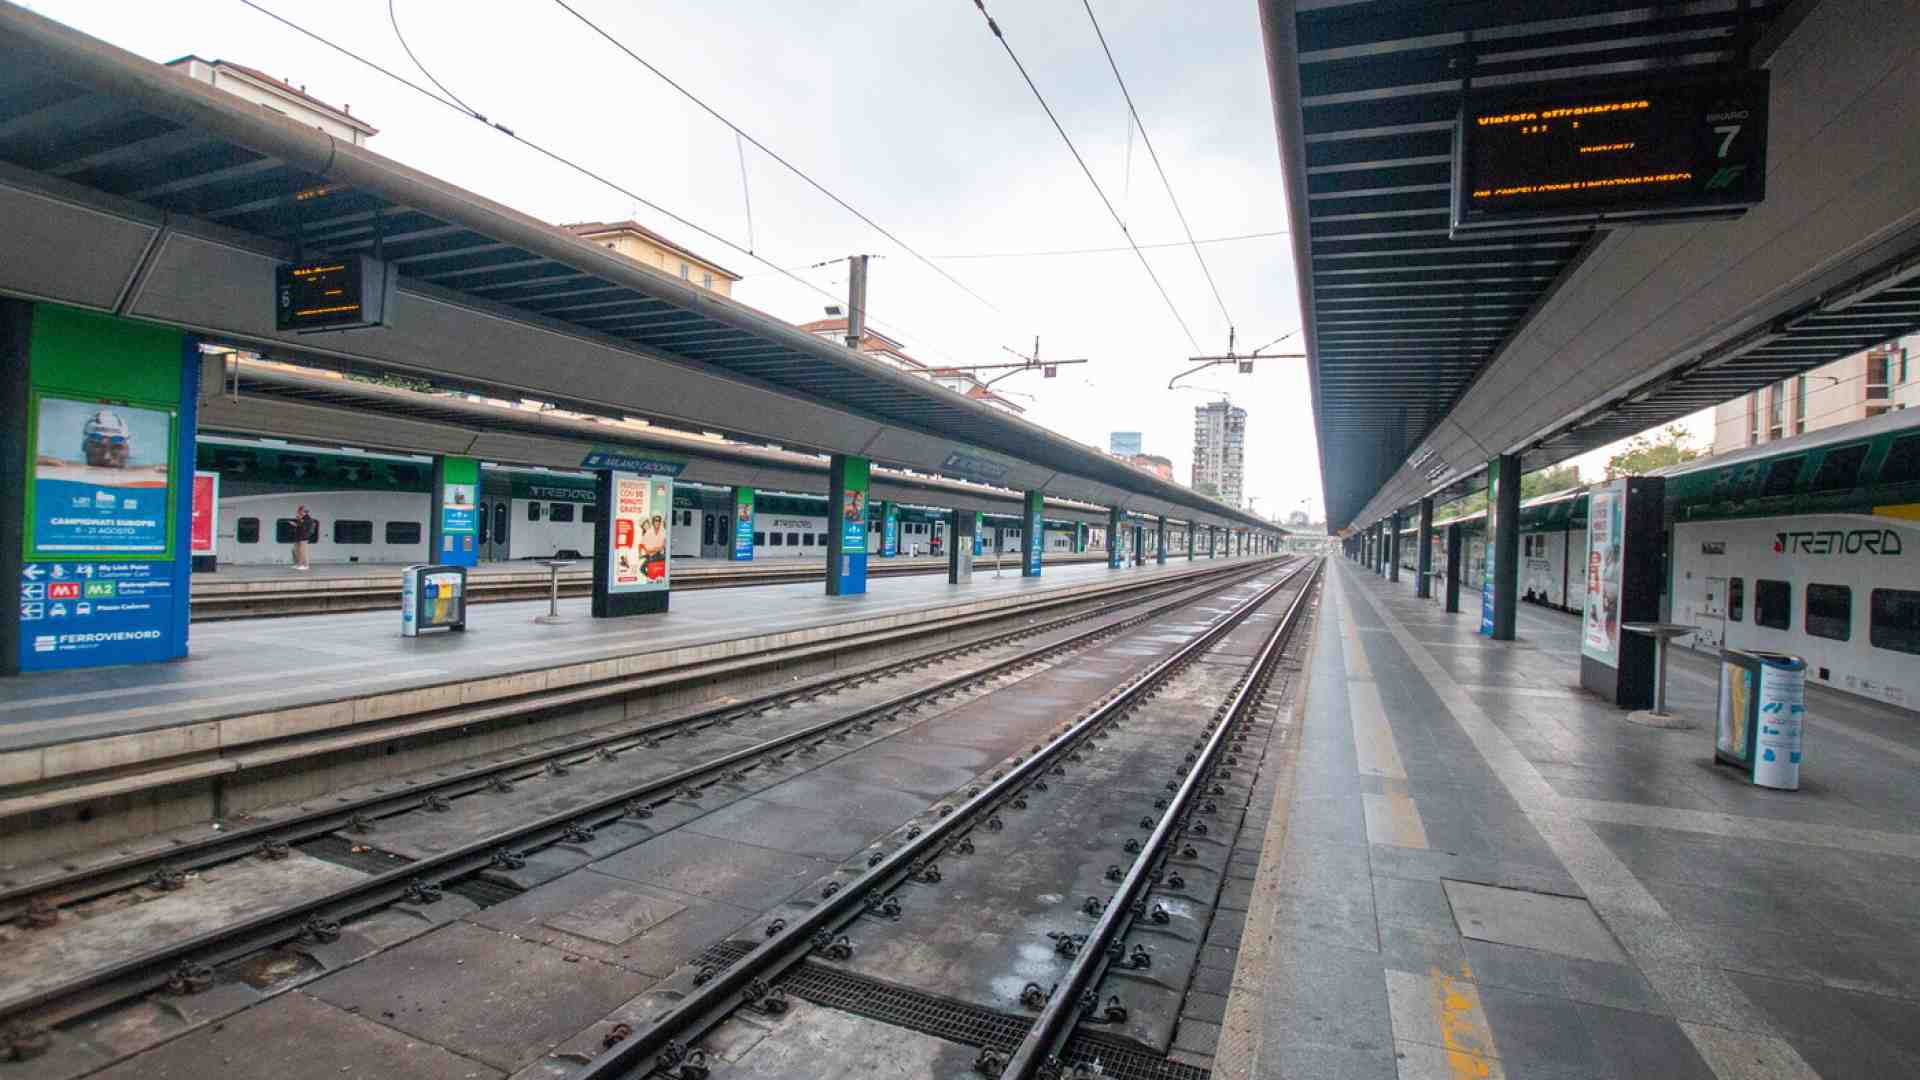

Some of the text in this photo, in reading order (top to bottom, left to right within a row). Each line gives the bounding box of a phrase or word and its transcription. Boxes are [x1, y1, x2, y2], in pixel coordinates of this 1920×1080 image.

[1713, 125, 1741, 158] 7
[537, 486, 597, 501] TRENORD
[98, 527, 136, 535] AGOSTO
[1789, 529, 1902, 555] TRENORD
[53, 585, 79, 596] M1
[87, 584, 113, 595] M2
[59, 630, 161, 643] FERROVIENORD
